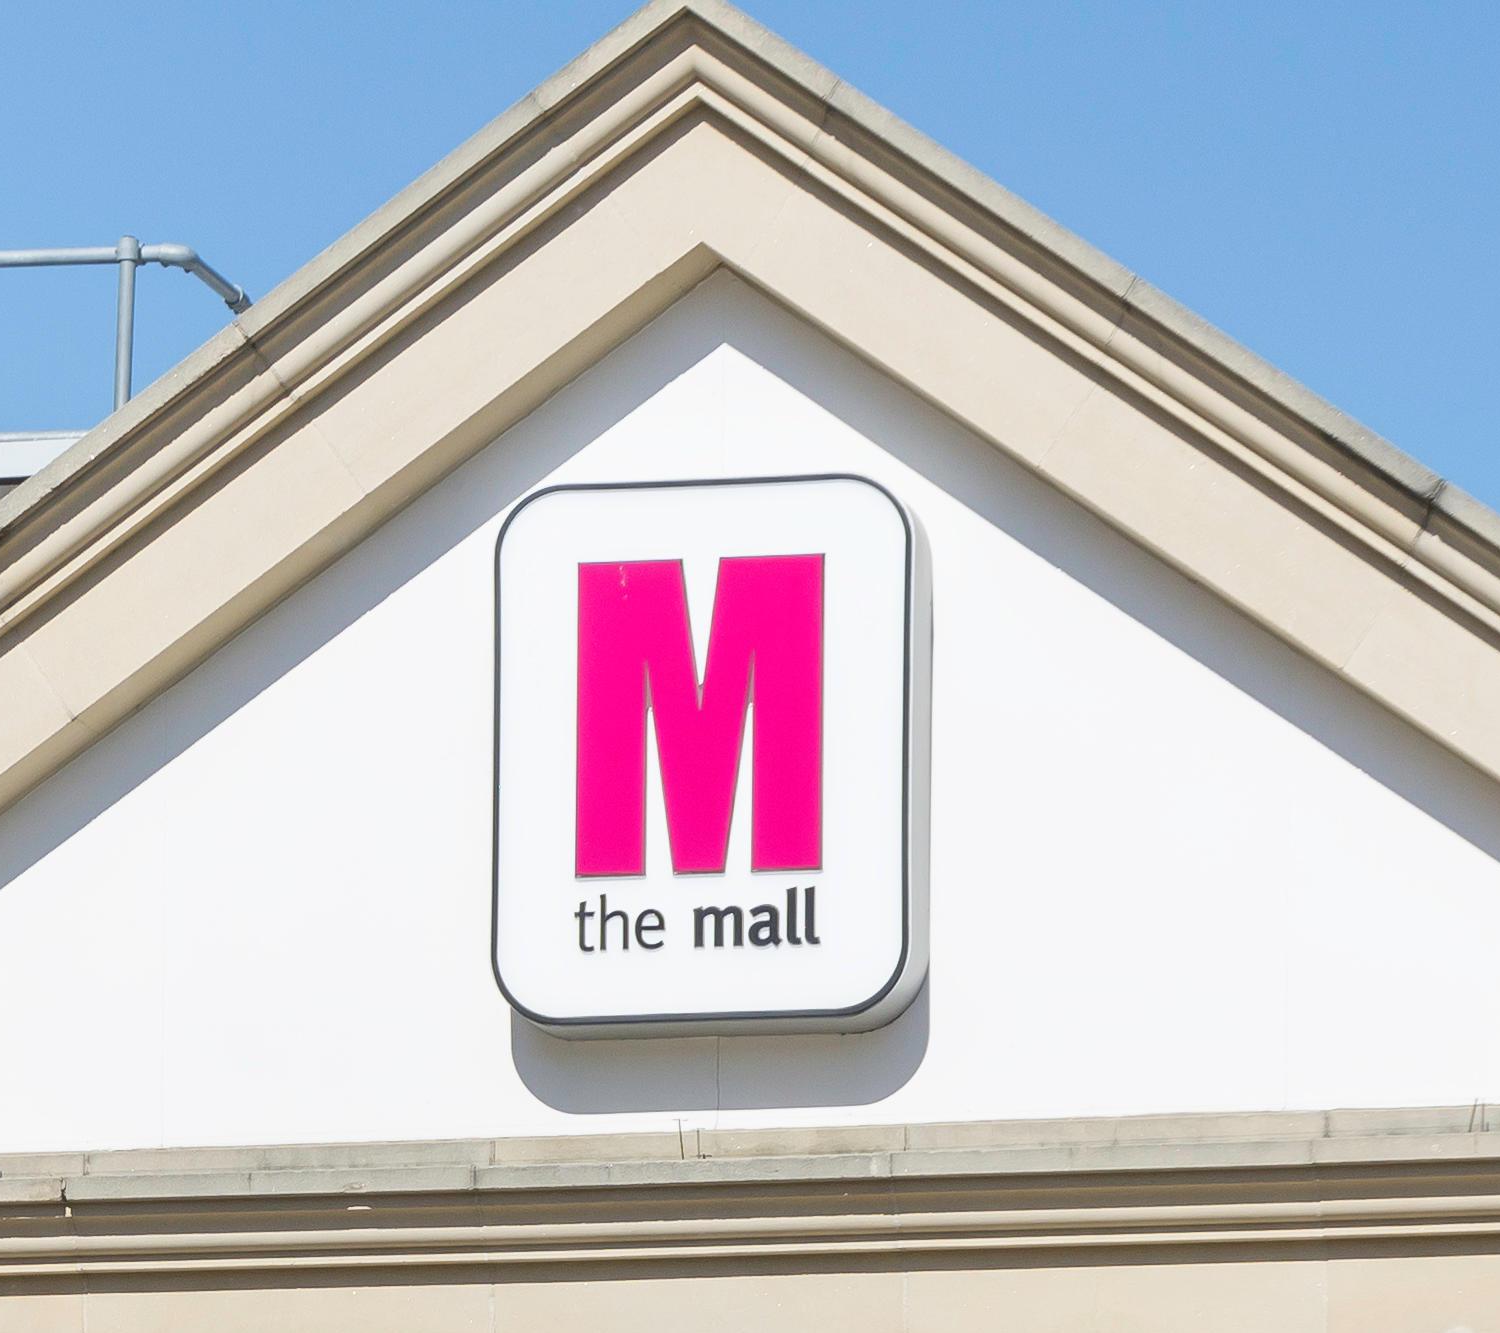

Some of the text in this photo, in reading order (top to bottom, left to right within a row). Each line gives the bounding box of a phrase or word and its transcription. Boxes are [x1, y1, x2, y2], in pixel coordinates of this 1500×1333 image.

[575, 553, 826, 878] M
[575, 887, 821, 953] the mall
